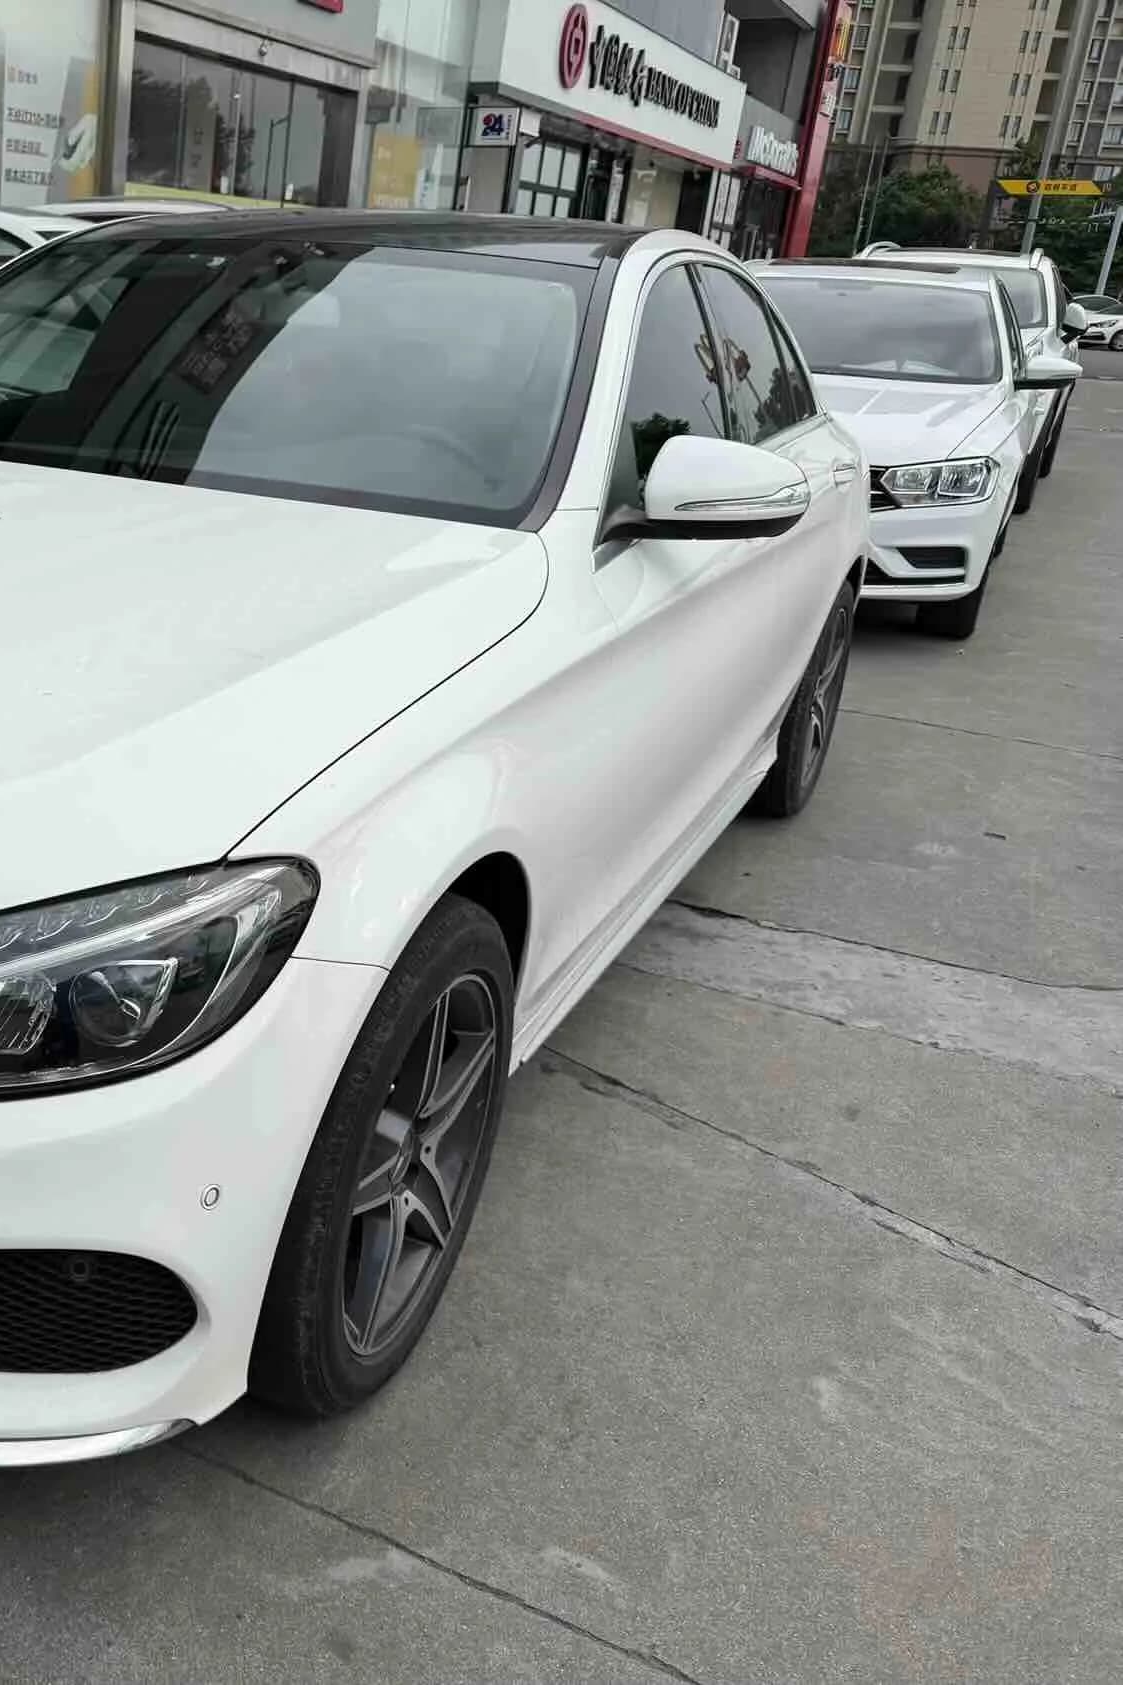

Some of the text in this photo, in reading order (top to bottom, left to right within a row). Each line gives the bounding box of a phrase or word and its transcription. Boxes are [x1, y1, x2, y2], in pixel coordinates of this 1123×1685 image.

[588, 24, 646, 107] 中国银行
[644, 66, 720, 129] BANK OF CHINA
